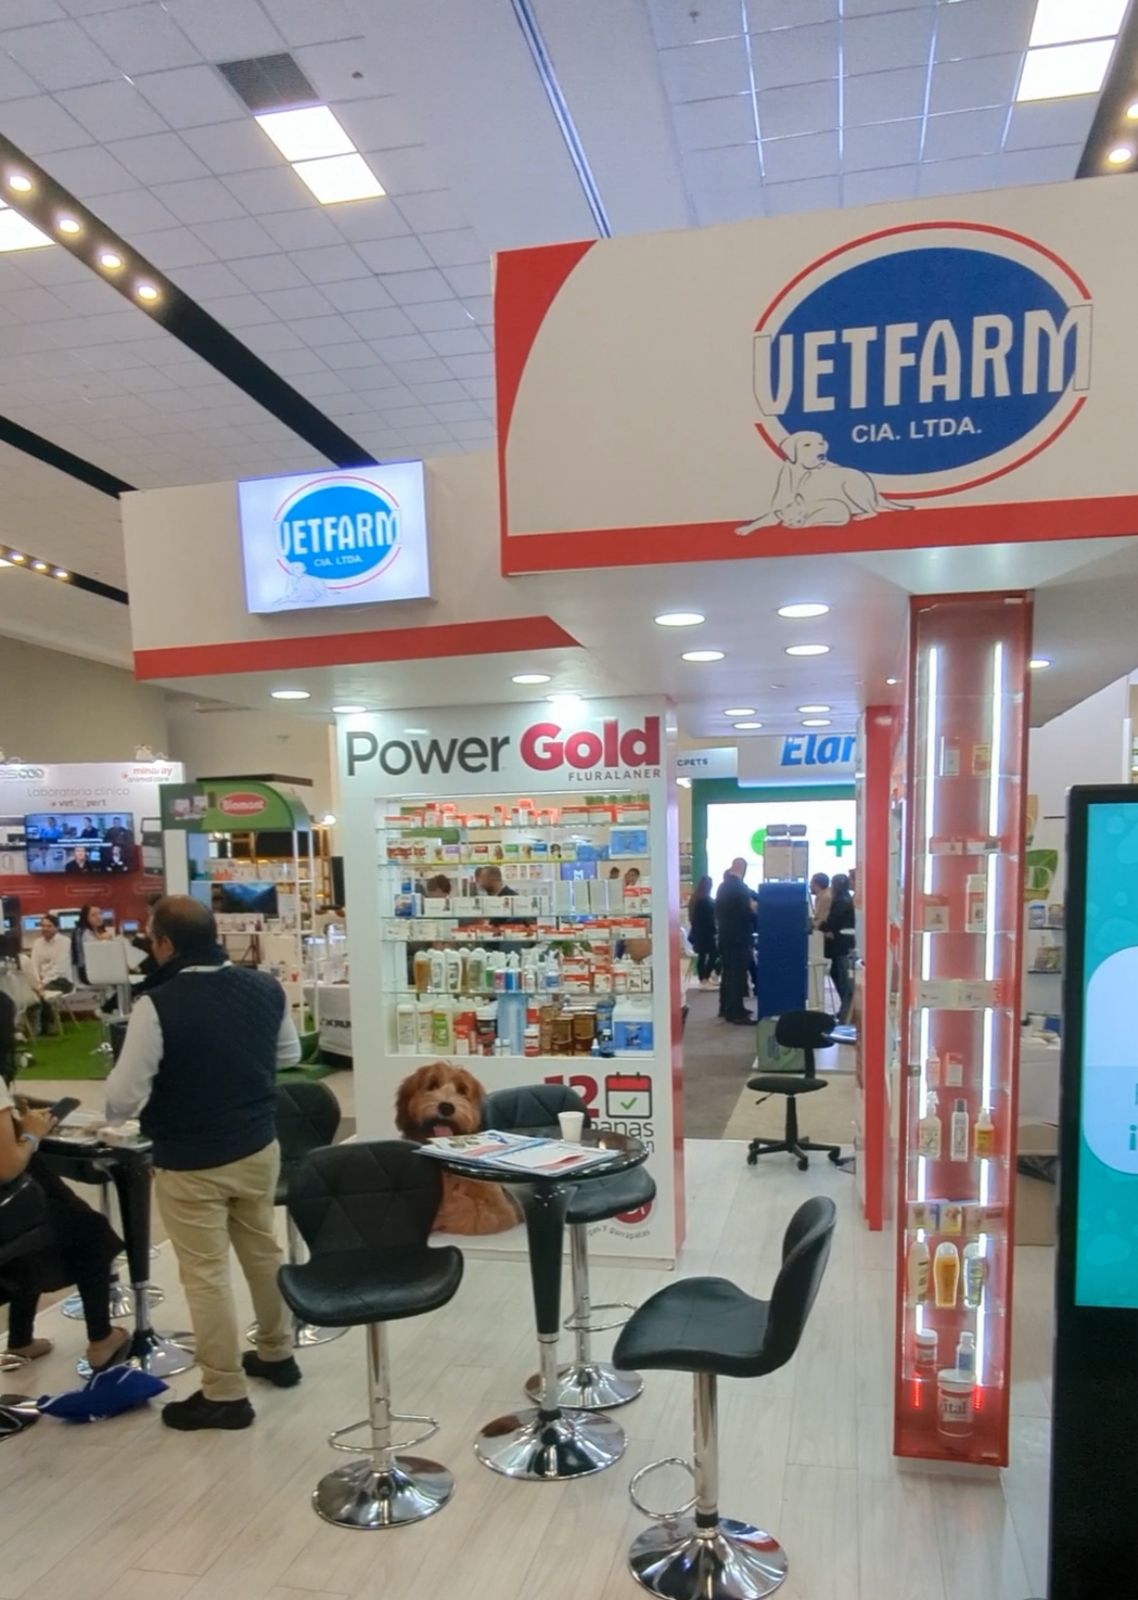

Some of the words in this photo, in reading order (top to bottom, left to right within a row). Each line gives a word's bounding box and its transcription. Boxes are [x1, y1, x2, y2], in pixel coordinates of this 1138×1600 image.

[753, 304, 1093, 416] VETFARM
[851, 422, 901, 444] CIA.
[909, 416, 982, 439] LTDA.
[273, 509, 401, 557] VETFARM
[345, 732, 510, 776] Power
[520, 716, 661, 771] Gold
[568, 769, 661, 782] FLURALANER
[544, 1074, 600, 1119] 2
